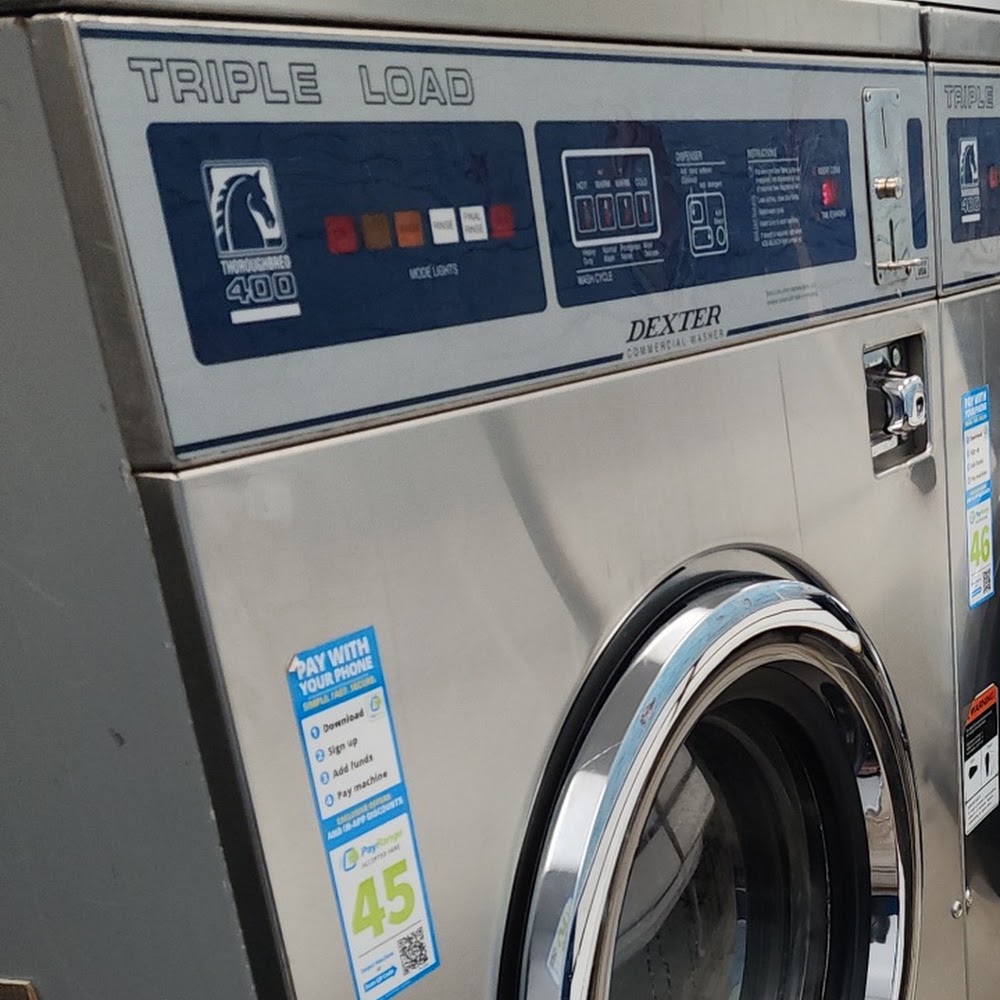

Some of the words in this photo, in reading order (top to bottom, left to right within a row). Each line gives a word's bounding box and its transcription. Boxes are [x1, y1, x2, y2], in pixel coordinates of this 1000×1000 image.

[128, 56, 322, 105] TRIPLE
[358, 64, 475, 106] LOAD
[944, 84, 994, 109] TRIPLE
[409, 266, 432, 280] MODE
[432, 263, 459, 277] LIGHTS
[226, 271, 298, 304] 400
[626, 304, 722, 343] DEXTER
[626, 337, 687, 359] COMMERCIAL
[690, 329, 725, 347] WASHER
[970, 525, 990, 566] 46
[296, 652, 327, 680] PAY
[328, 636, 370, 667] WITH
[299, 668, 336, 696] YOUR
[336, 656, 374, 682] PHONE
[322, 708, 364, 733] Download
[328, 742, 346, 757] Sign
[347, 736, 358, 748] up
[332, 765, 348, 779] Add
[351, 754, 374, 770] funds
[337, 786, 352, 800] Pay
[353, 770, 388, 792] machine
[352, 858, 415, 938] 45
